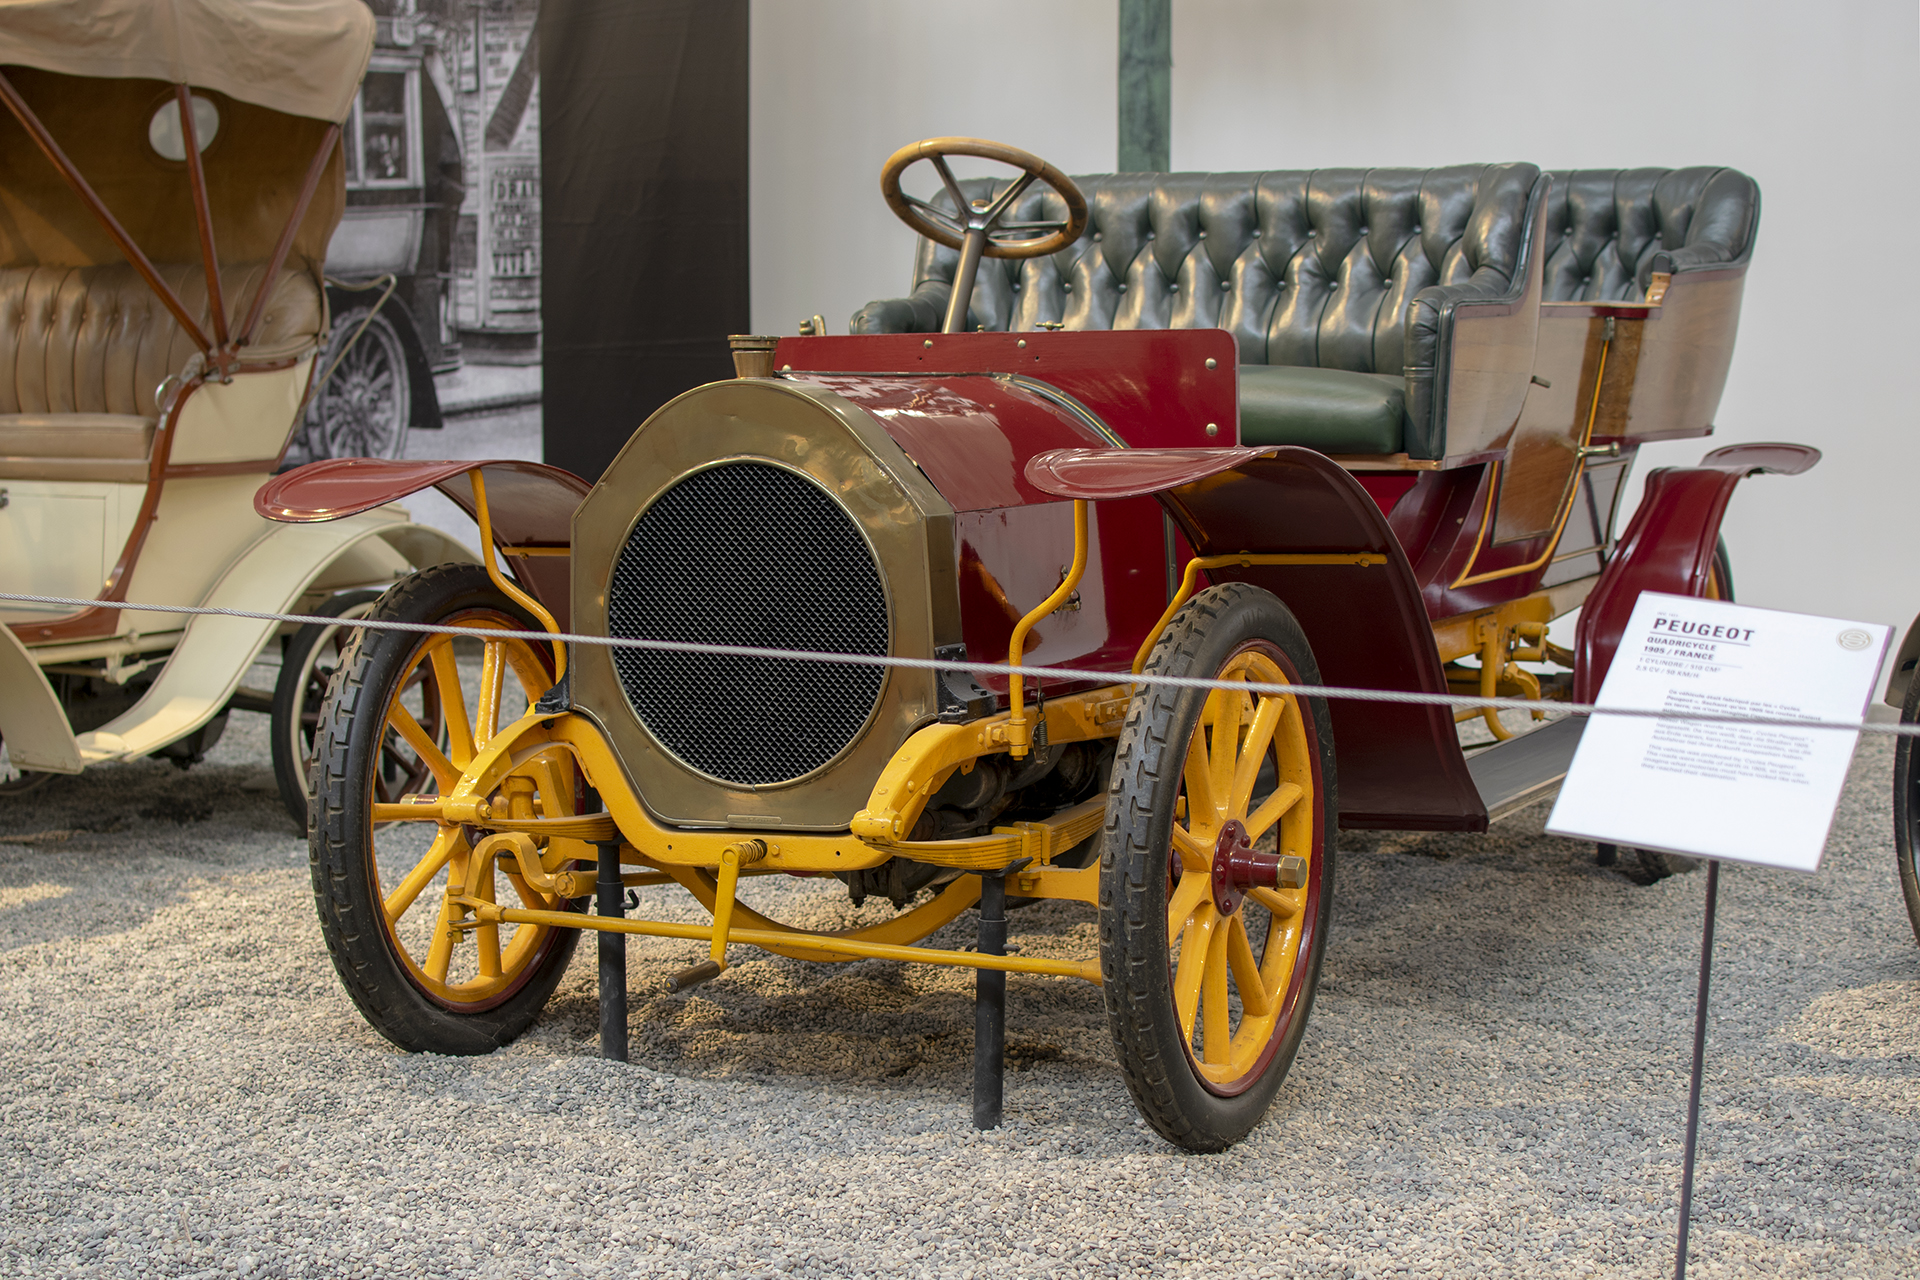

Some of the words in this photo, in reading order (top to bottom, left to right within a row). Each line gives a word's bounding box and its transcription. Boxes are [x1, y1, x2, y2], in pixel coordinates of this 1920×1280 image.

[1653, 618, 1755, 641] PEUGEOT
[1647, 636, 1716, 651] QUADRICYCLE
[1644, 646, 1665, 654] 1905
[1674, 650, 1714, 660] FRANCE
[1645, 658, 1684, 668] CYLINDRE
[1676, 669, 1700, 678] KM/H
[1678, 690, 1704, 698] véhicule
[1666, 695, 1692, 703] Peugeot
[1701, 752, 1732, 760] produced
